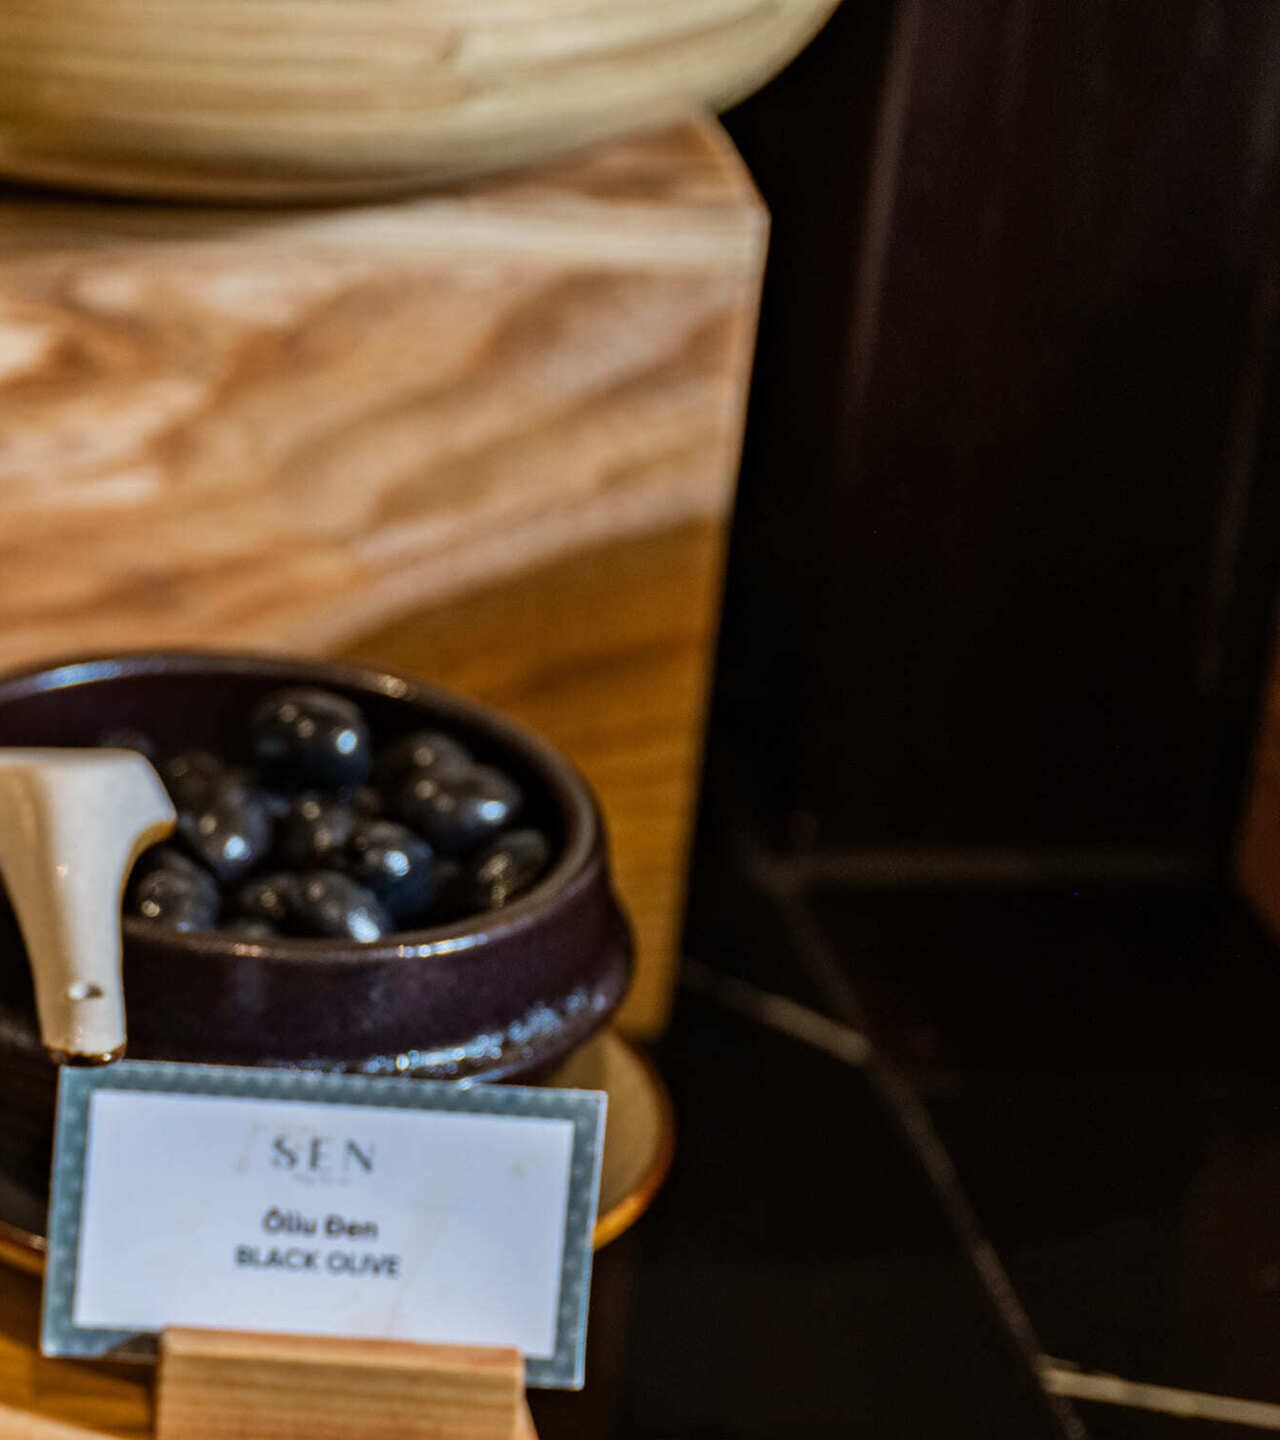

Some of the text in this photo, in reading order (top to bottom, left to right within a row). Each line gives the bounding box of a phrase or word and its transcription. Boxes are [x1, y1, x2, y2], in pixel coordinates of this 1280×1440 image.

[272, 1136, 375, 1173] SEN
[235, 1244, 400, 1279] BLACK OLIVE
